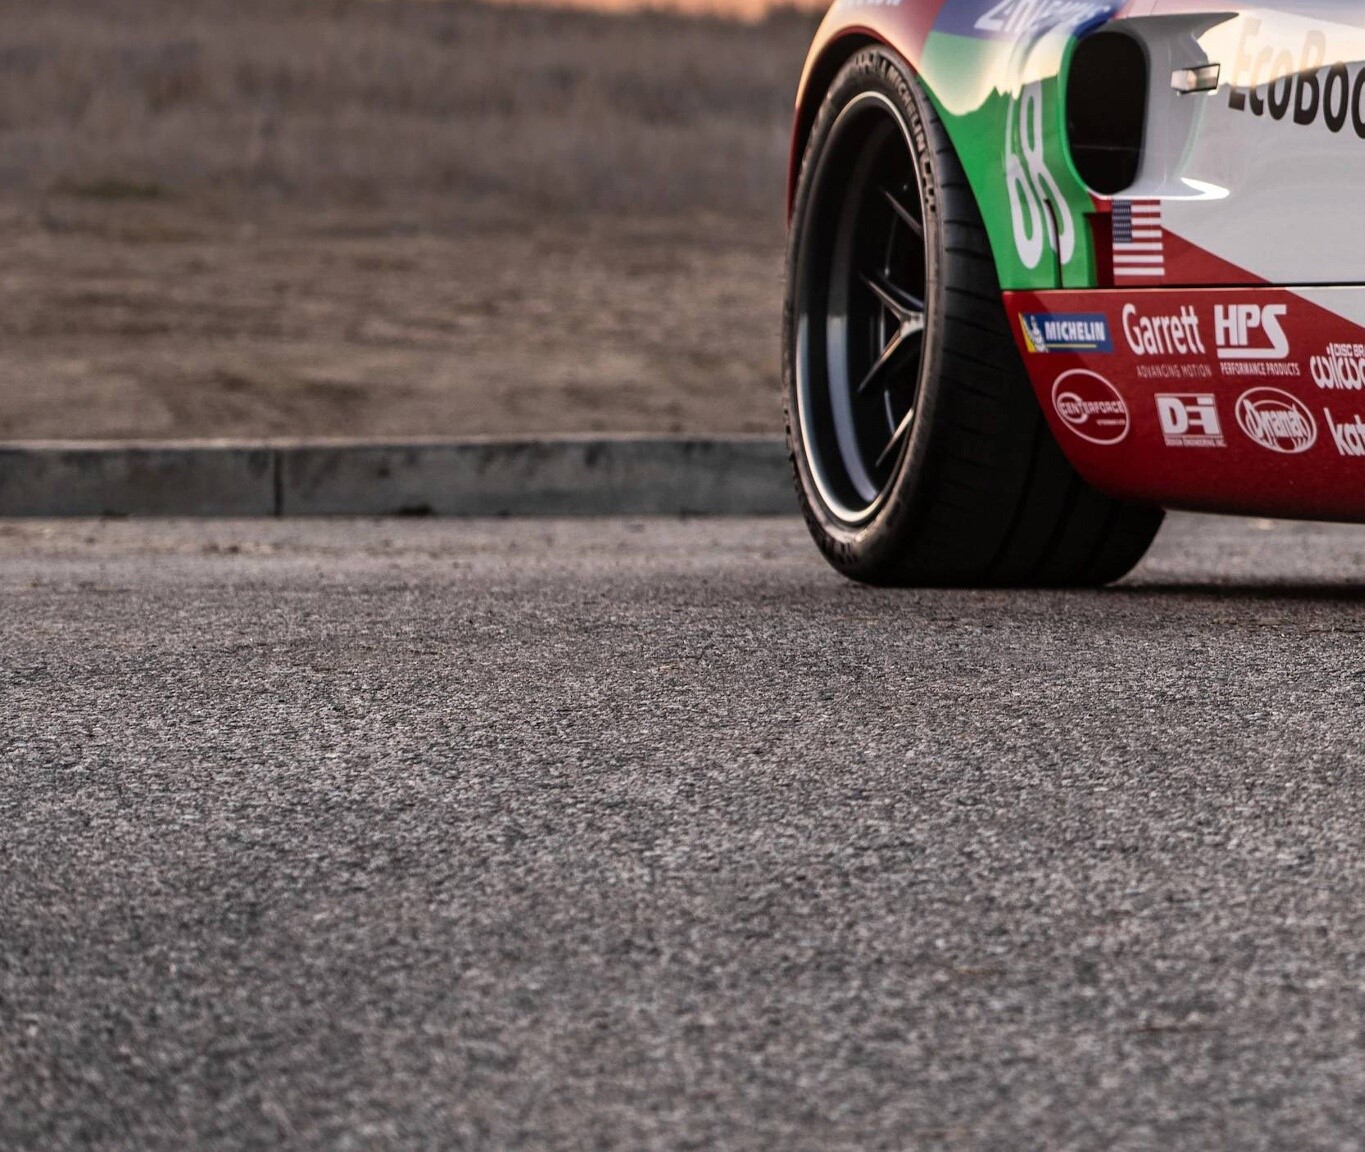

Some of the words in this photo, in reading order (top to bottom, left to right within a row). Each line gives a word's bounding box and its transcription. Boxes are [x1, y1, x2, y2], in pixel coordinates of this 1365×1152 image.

[1044, 321, 1106, 342] MICHELIN
[1121, 303, 1206, 356] Garrett
[1213, 304, 1290, 359] HPS
[1333, 343, 1352, 357] DISC
[1181, 364, 1212, 378] MOTION
[1220, 362, 1264, 376] PERFORMANCE
[1265, 362, 1301, 377] PRODUCTS
